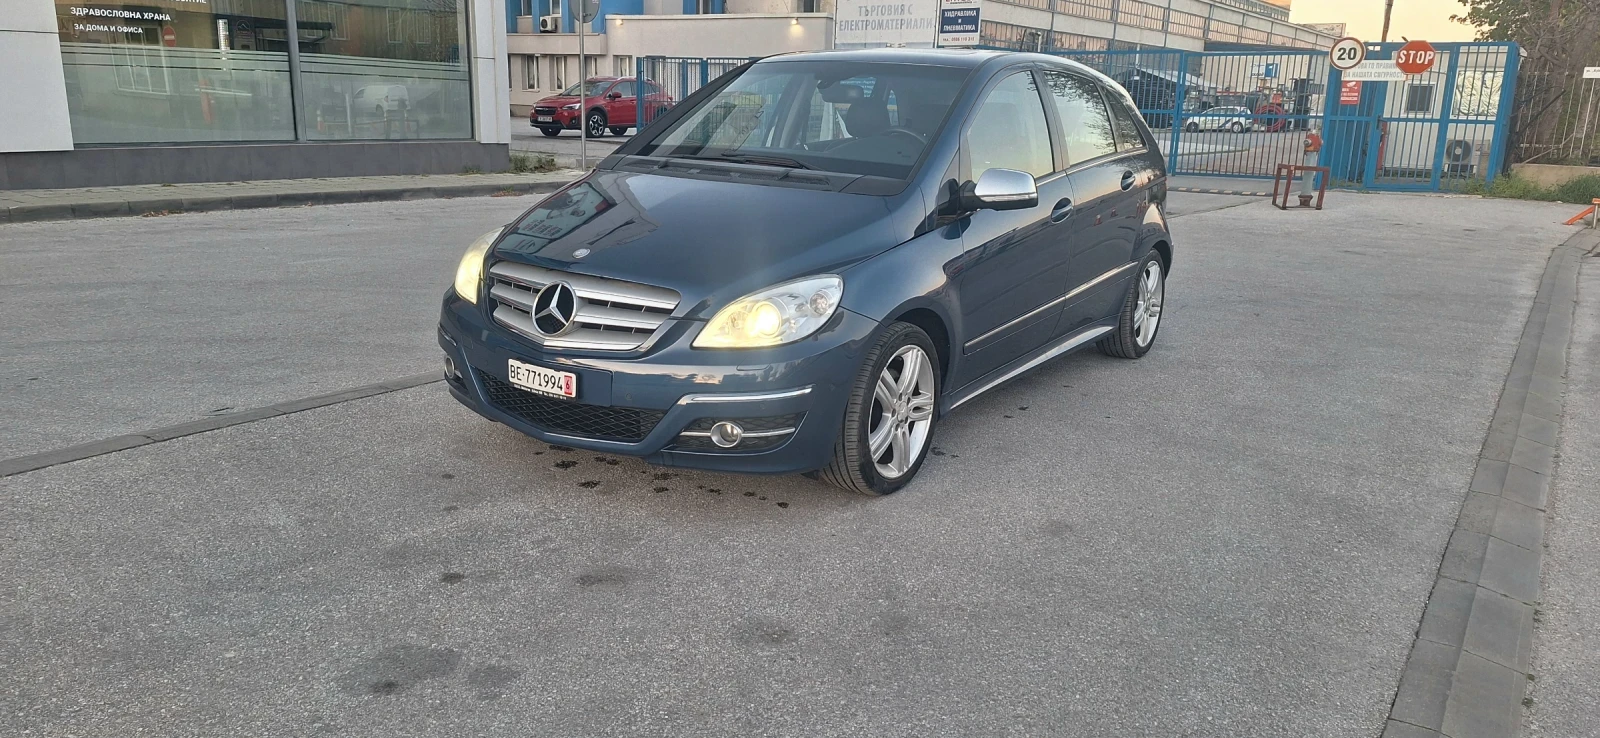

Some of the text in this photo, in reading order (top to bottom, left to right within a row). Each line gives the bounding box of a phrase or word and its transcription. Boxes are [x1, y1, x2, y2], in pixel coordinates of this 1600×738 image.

[70, 7, 172, 21] ЗДРАВОСЛОВНА ХРАНА
[858, 4, 913, 17] ТЪРГОВИЯ С
[944, 10, 977, 18] ХИДРАВЛИКА
[86, 24, 109, 32] ДОМА
[117, 26, 143, 34] ОФИСА
[839, 17, 933, 32] ЕЛЕКТРОМАТЕРИАЛИ
[943, 24, 976, 32] ПНЕВМАТИКА
[1336, 47, 1357, 61] 20
[1398, 50, 1434, 65] STOP
[565, 379, 570, 390] 6
